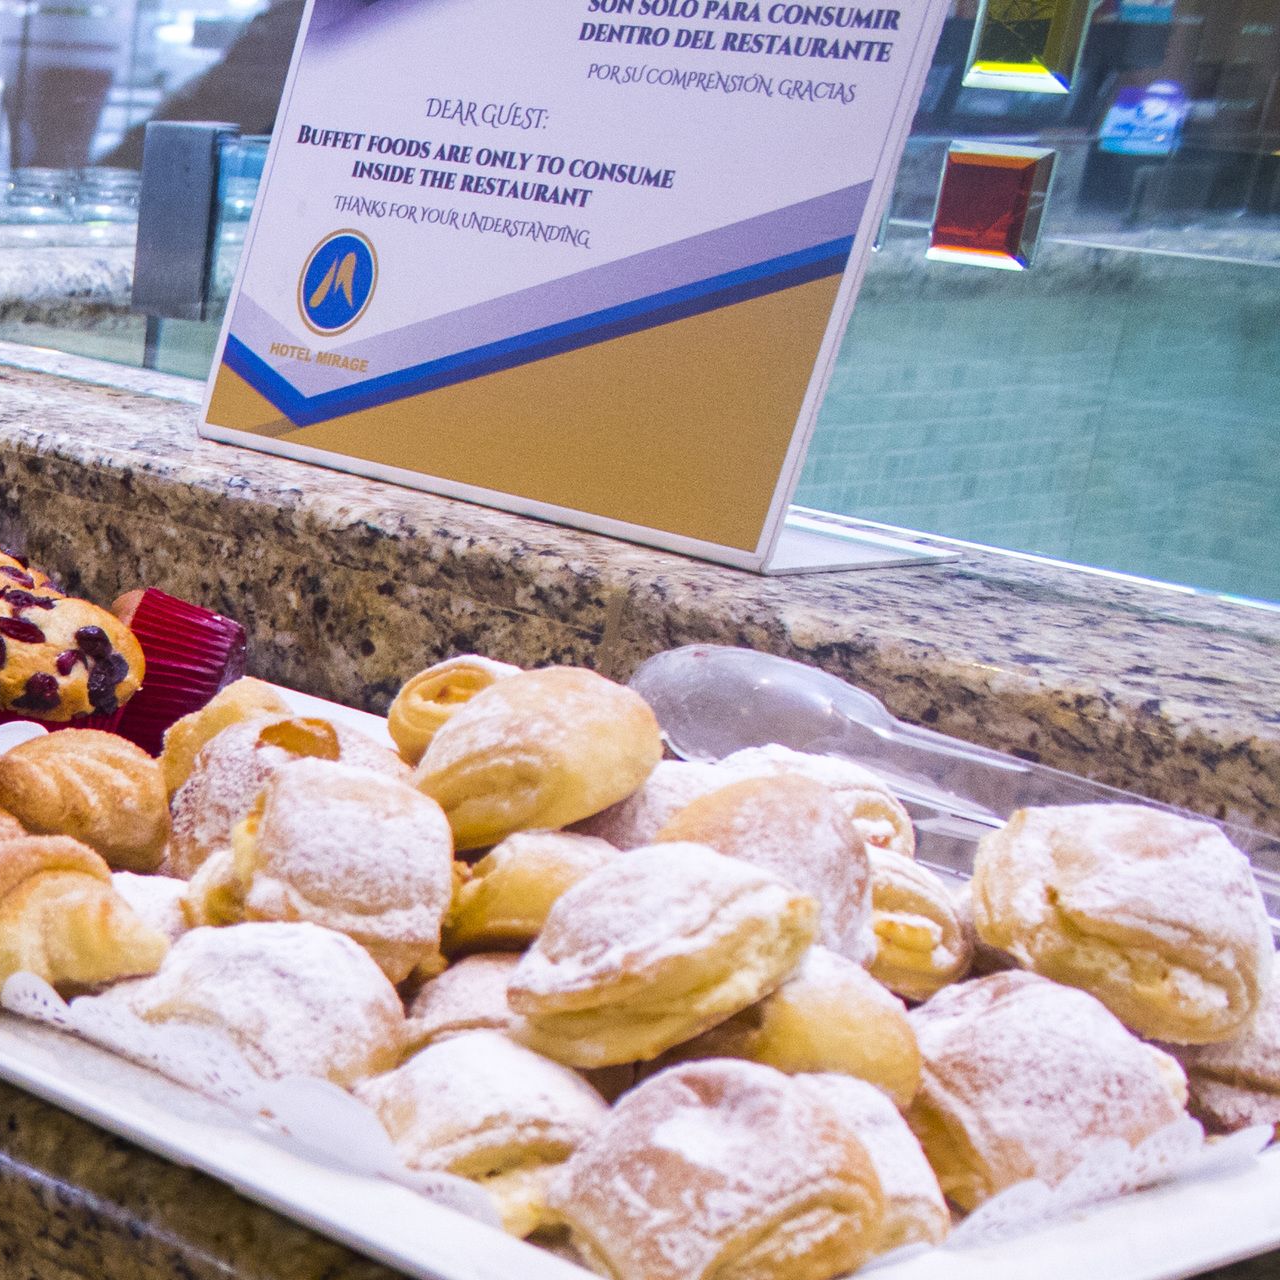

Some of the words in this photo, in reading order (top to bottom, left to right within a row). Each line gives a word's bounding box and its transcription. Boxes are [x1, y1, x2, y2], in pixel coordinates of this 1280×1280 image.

[588, 0, 634, 14] SON
[638, 0, 699, 18] SOLO
[703, 0, 761, 23] PARA
[768, 3, 901, 31] CONSUMIR
[579, 22, 670, 47] DENTRO
[674, 28, 716, 50] DEL
[721, 31, 893, 63] RESTAURANTE
[587, 63, 621, 84] POR
[622, 65, 646, 83] SU
[778, 78, 856, 105] GRACIAS
[426, 98, 478, 127] DEAR
[481, 102, 550, 130] GUEST:
[366, 136, 431, 159] FOODS
[433, 143, 473, 165] ARE
[475, 147, 533, 173] ONLY
[536, 154, 566, 175] TO
[568, 159, 676, 189] CONSUME
[351, 161, 415, 185] INSIDE
[419, 170, 456, 190] THE
[459, 173, 594, 208] RESTAURANT
[333, 195, 386, 218] THANKS
[389, 203, 420, 223] FOR
[419, 207, 459, 229] YOUR
[460, 211, 592, 249] UNDERSTANDING
[269, 342, 311, 362] HOTEL
[315, 351, 369, 374] MIRAGE
